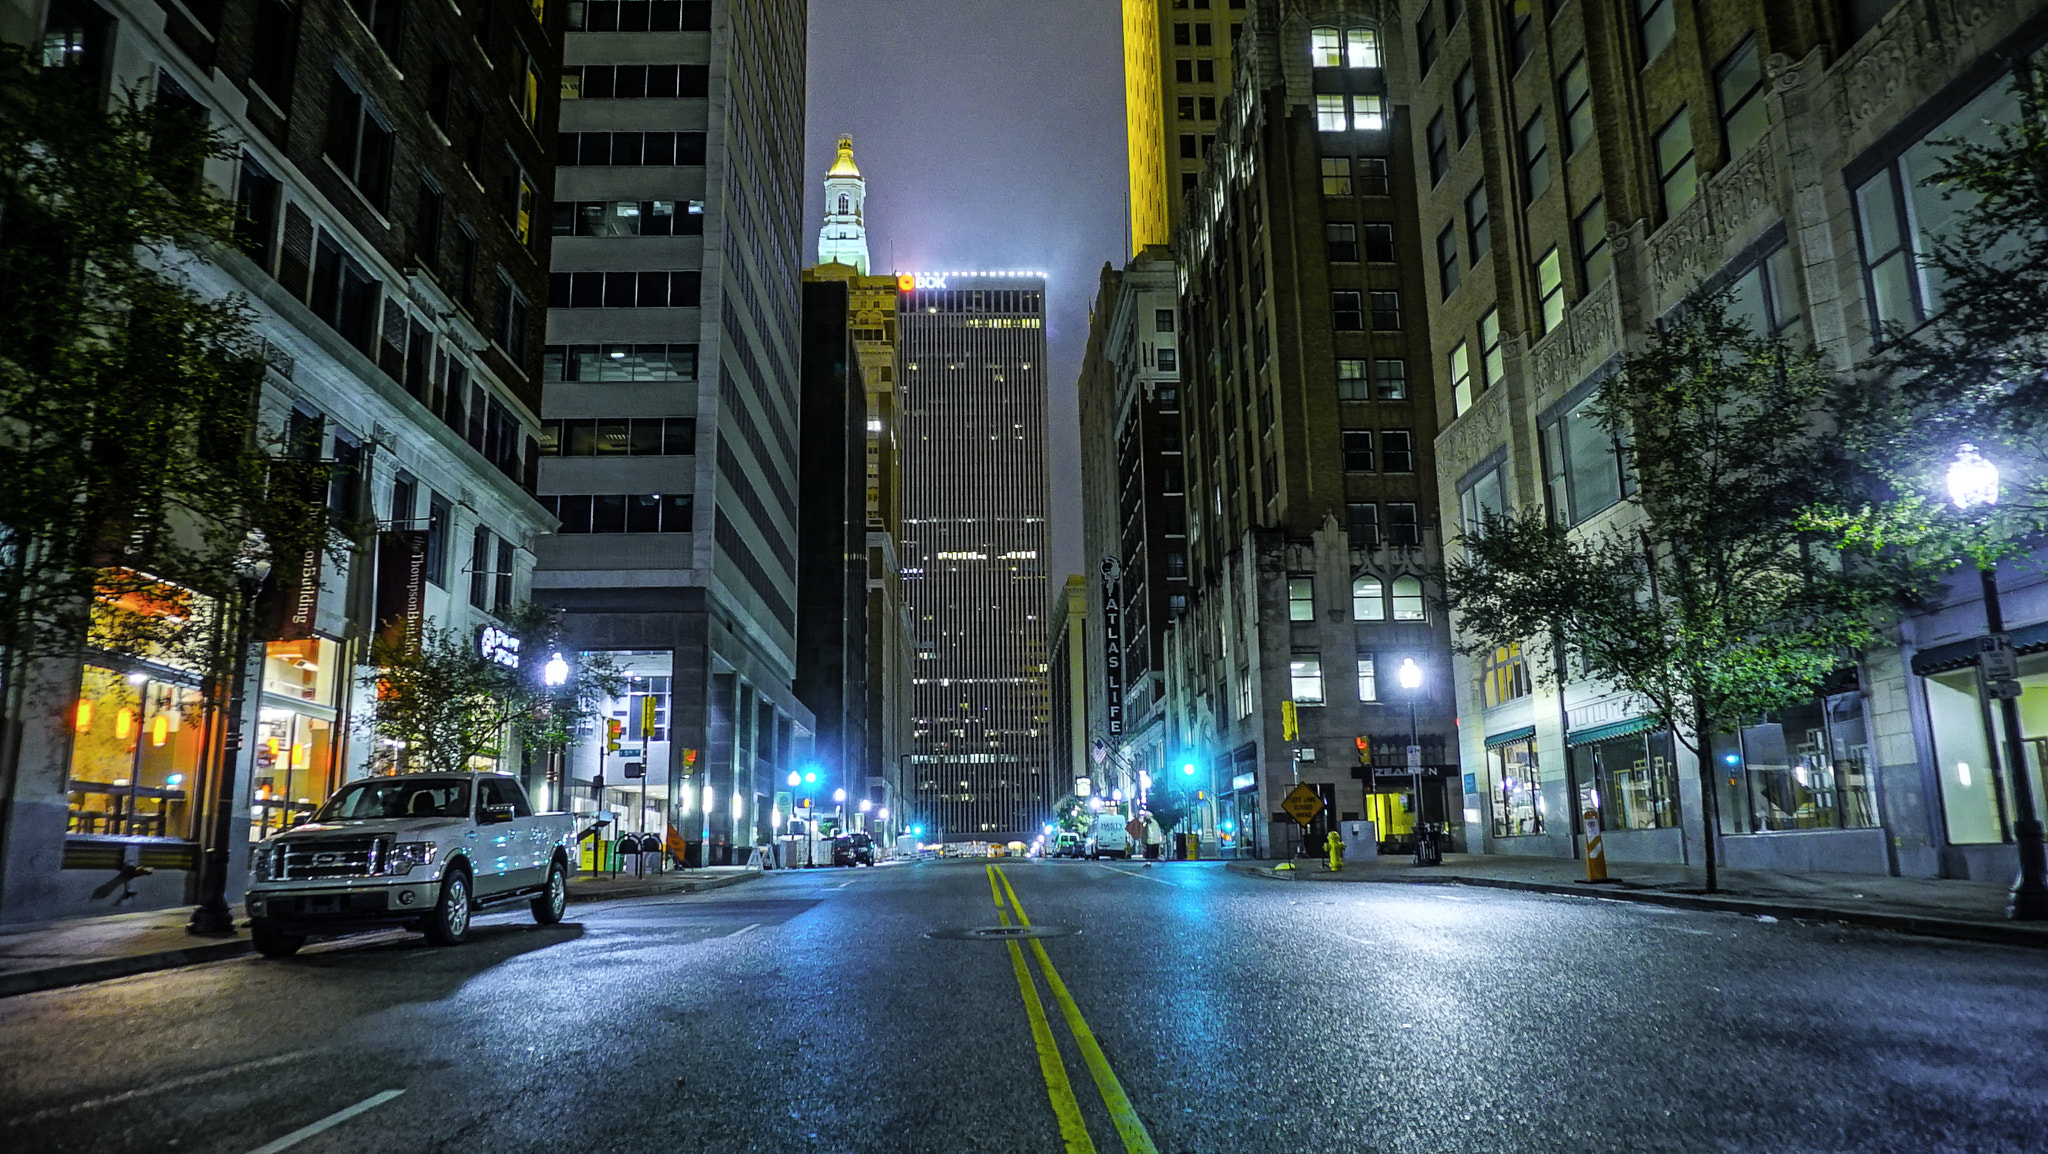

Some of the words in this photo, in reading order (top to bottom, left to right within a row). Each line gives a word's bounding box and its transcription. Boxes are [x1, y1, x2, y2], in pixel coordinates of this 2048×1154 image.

[915, 276, 947, 289] BOK
[1105, 602, 1120, 669] ATLAS
[1108, 676, 1122, 733] LIFE
